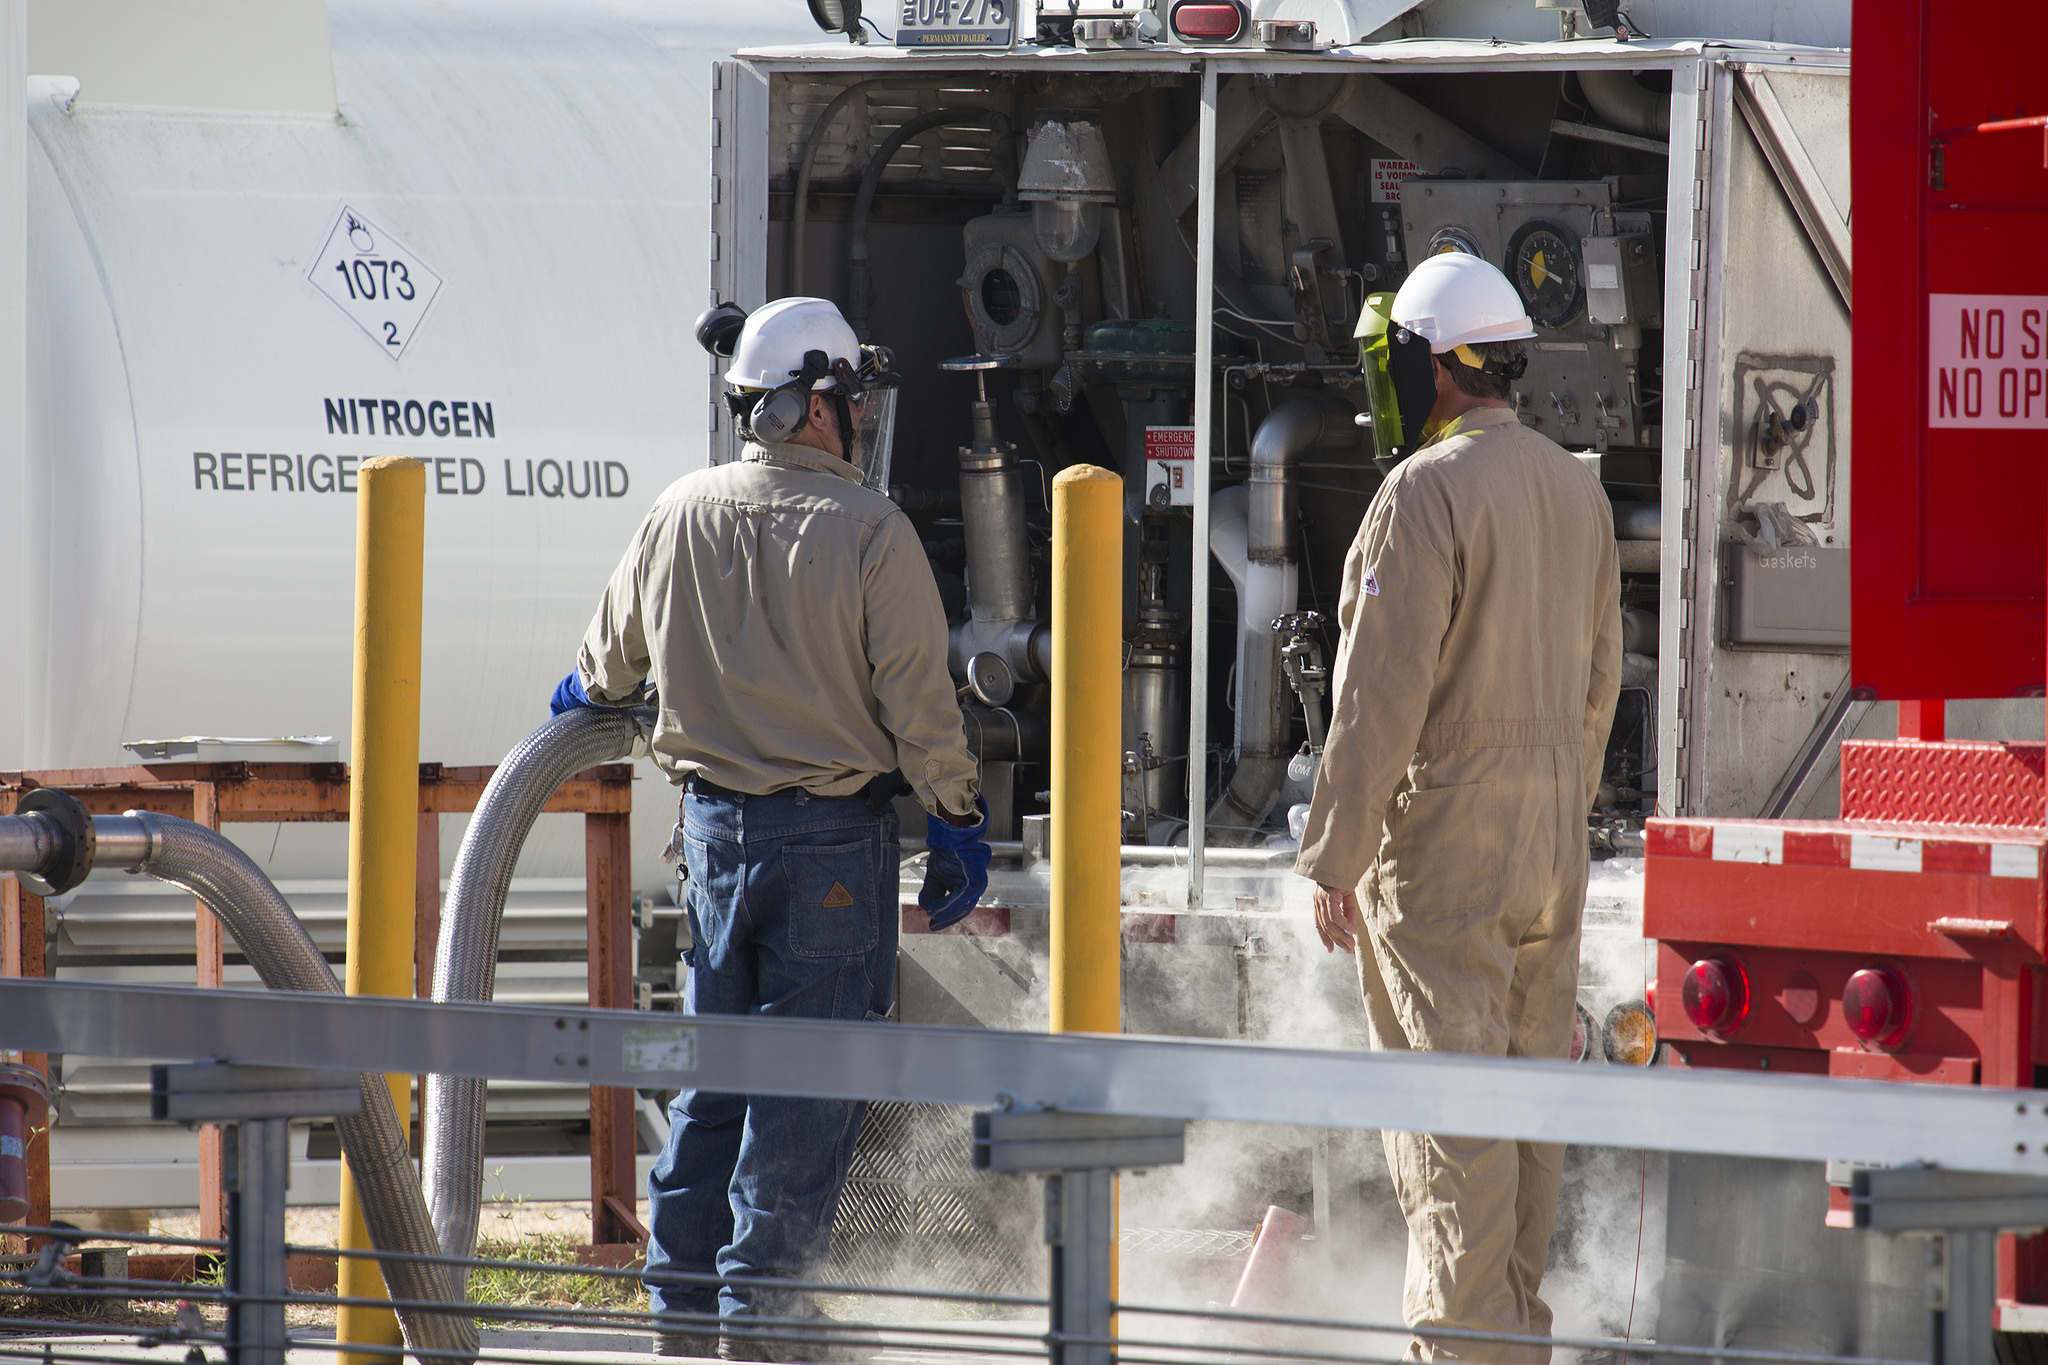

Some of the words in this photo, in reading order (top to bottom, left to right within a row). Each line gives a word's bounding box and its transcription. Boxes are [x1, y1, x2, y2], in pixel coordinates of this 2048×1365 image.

[922, 34, 959, 43] PERMANENT
[960, 34, 986, 43] TRAILER
[1375, 171, 1383, 179] IS
[1380, 182, 1400, 190] SEAL
[335, 259, 416, 301] 1073
[383, 320, 401, 345] 2
[1961, 308, 2005, 360] NO
[2021, 308, 2048, 360] S
[1939, 367, 1982, 418] NO
[323, 397, 496, 438] NITROGEN
[1152, 431, 1194, 443] EMERGENC
[193, 452, 486, 496] REFRIGEED
[504, 458, 629, 499] LIQUID
[1758, 548, 1817, 569] Gaskets
